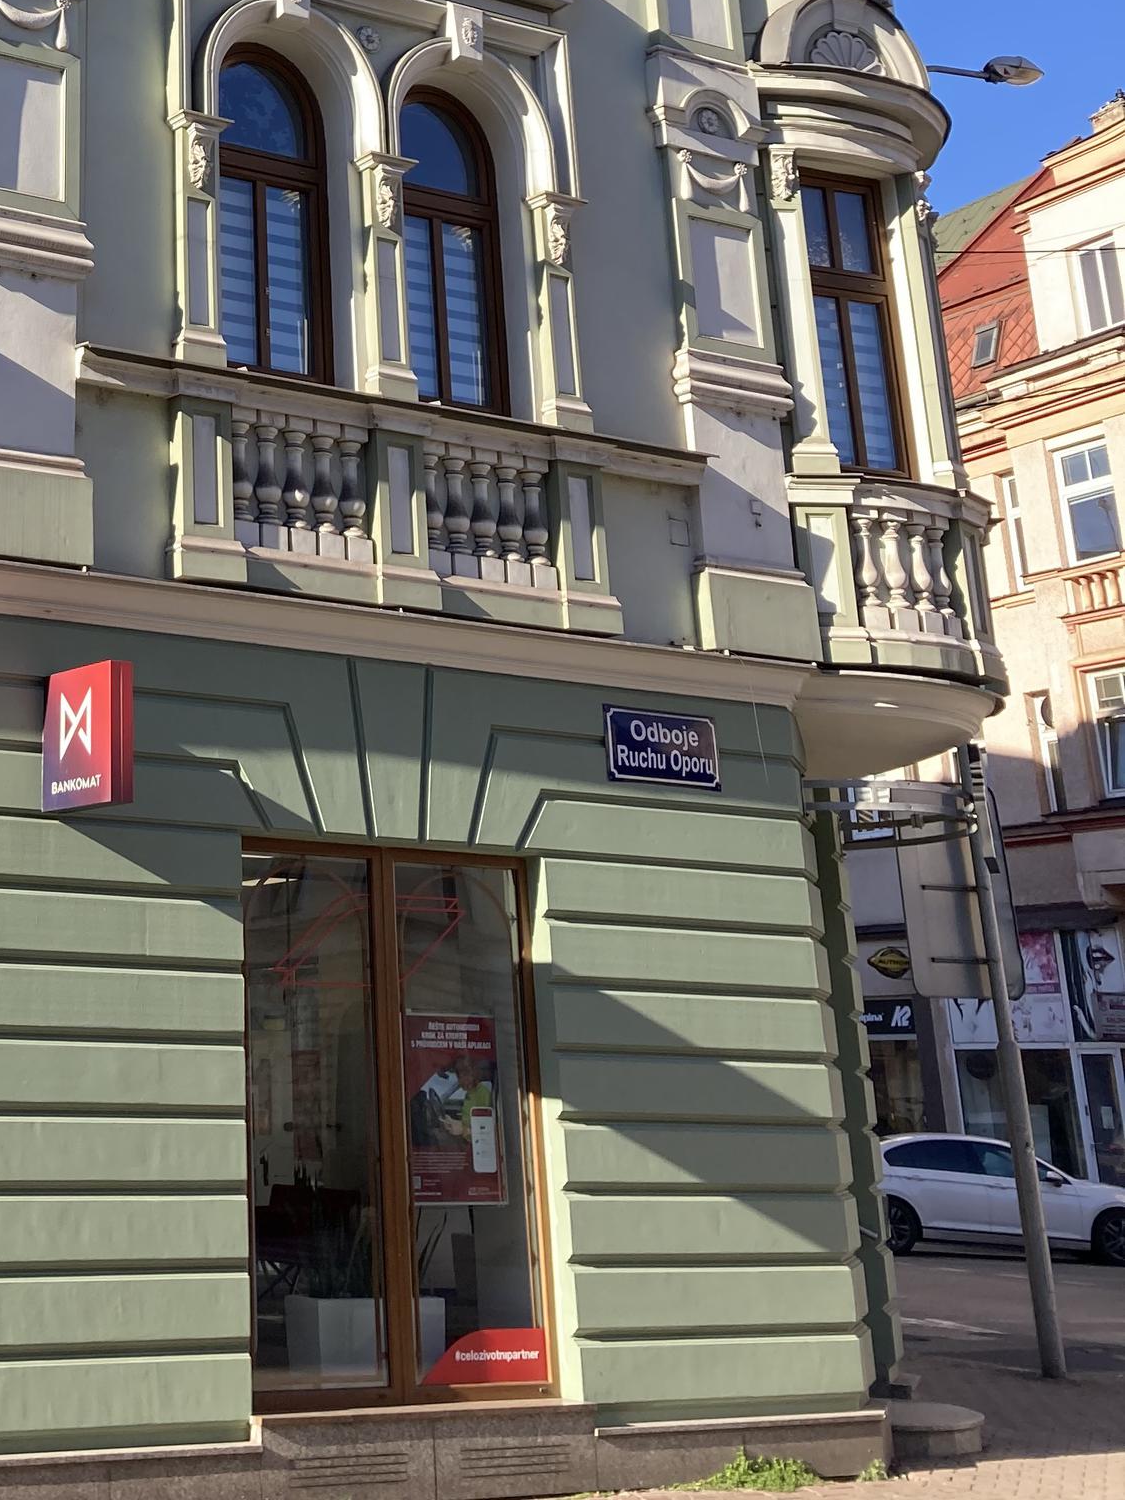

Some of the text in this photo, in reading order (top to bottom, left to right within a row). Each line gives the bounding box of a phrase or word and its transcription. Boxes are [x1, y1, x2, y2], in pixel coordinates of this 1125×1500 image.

[630, 719, 699, 751] Odboje
[616, 744, 715, 777] Ruchu Oporu
[51, 774, 102, 795] BANKOMAT
[890, 1005, 912, 1027] K2
